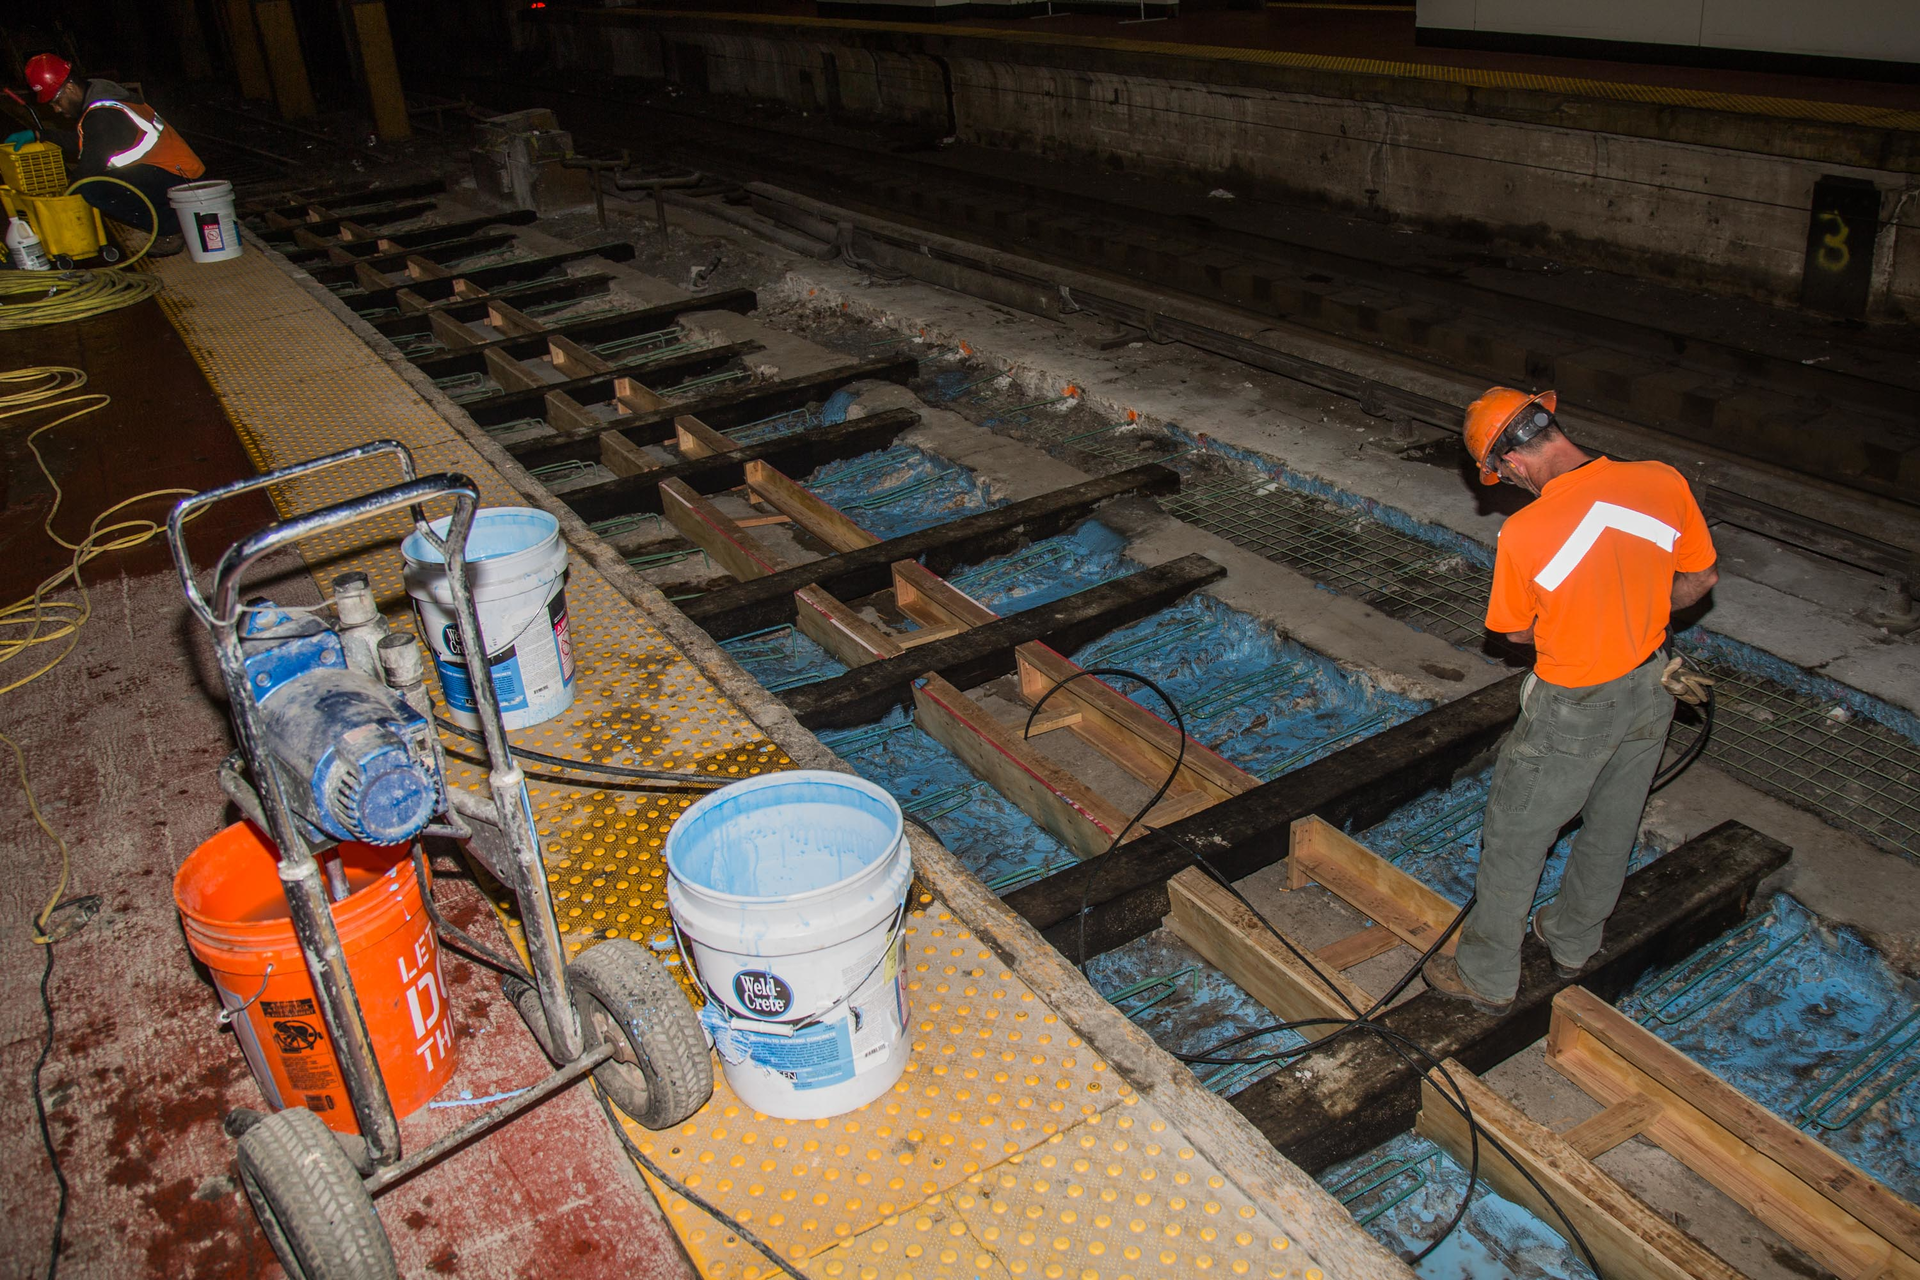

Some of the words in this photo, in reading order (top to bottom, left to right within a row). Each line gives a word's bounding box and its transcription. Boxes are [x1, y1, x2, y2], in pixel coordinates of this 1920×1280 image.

[1817, 209, 1850, 272] 3
[740, 975, 781, 996] Weld-
[744, 991, 784, 1012] Crete
